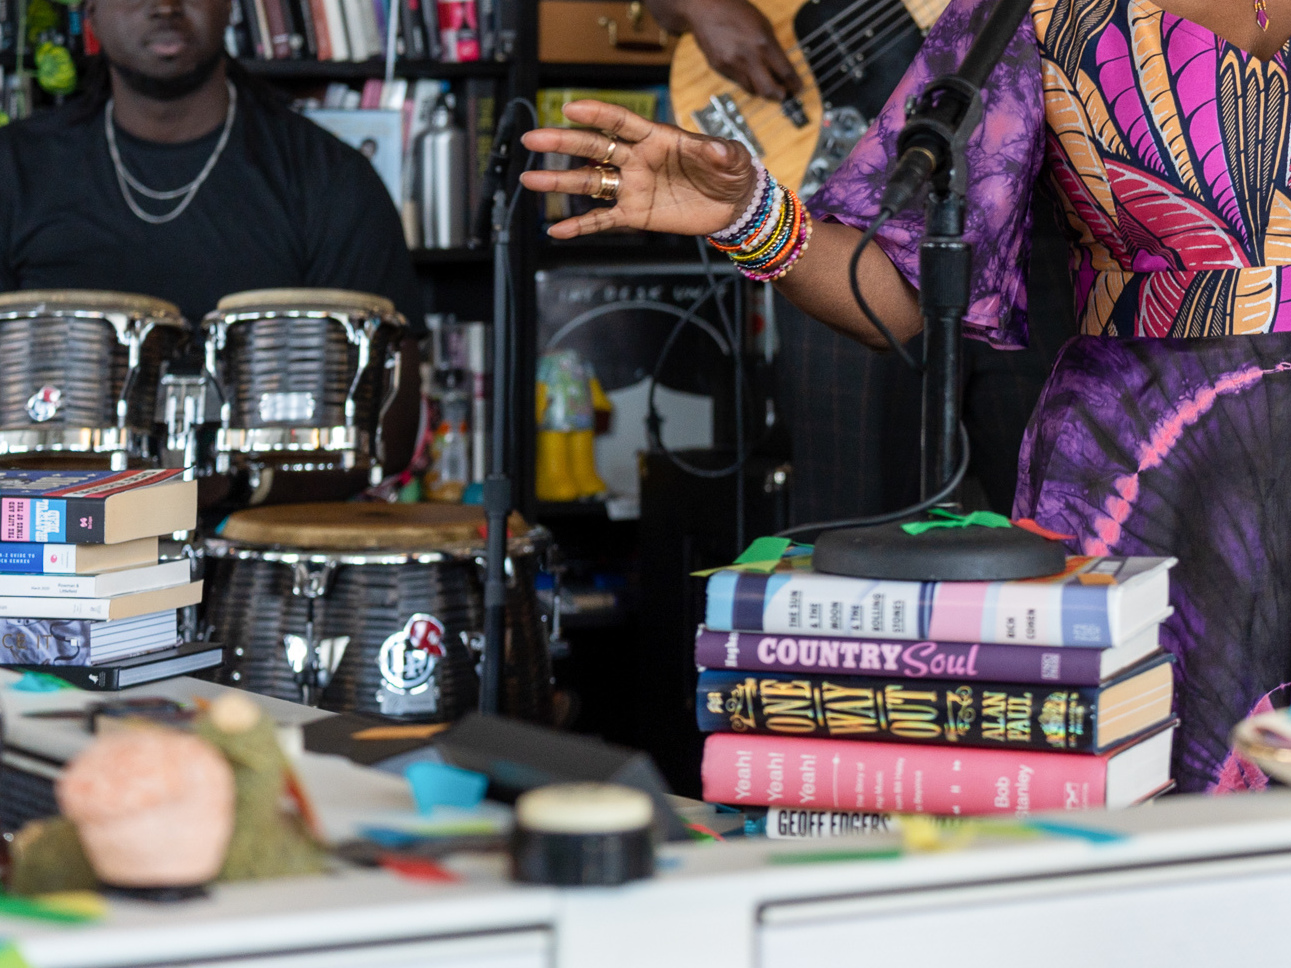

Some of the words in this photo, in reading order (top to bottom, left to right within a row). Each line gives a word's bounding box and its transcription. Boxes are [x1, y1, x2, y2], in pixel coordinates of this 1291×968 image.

[789, 590, 798, 609] SUN
[809, 603, 818, 619] THE
[830, 601, 839, 630] MOON
[851, 605, 860, 621] THE
[872, 594, 881, 632] ROLLING
[892, 600, 902, 633] STONES
[789, 612, 798, 628] THE
[1026, 609, 1036, 639] COHEN
[2, 633, 27, 649] CE
[37, 634, 53, 649] IT
[757, 637, 903, 671] COUNTRY
[902, 640, 981, 678] Soul
[760, 678, 816, 733] ONE
[821, 680, 879, 735] WAY
[884, 684, 942, 739] OUT
[981, 691, 1007, 743] ALAN
[1006, 691, 1033, 743] PAUL
[735, 750, 752, 800] Yeah!
[766, 751, 785, 802] Yeah!
[798, 753, 817, 804] Yeah!
[995, 776, 1010, 809] Bob
[1016, 764, 1034, 818] Stanley
[778, 809, 826, 838] GEOFF
